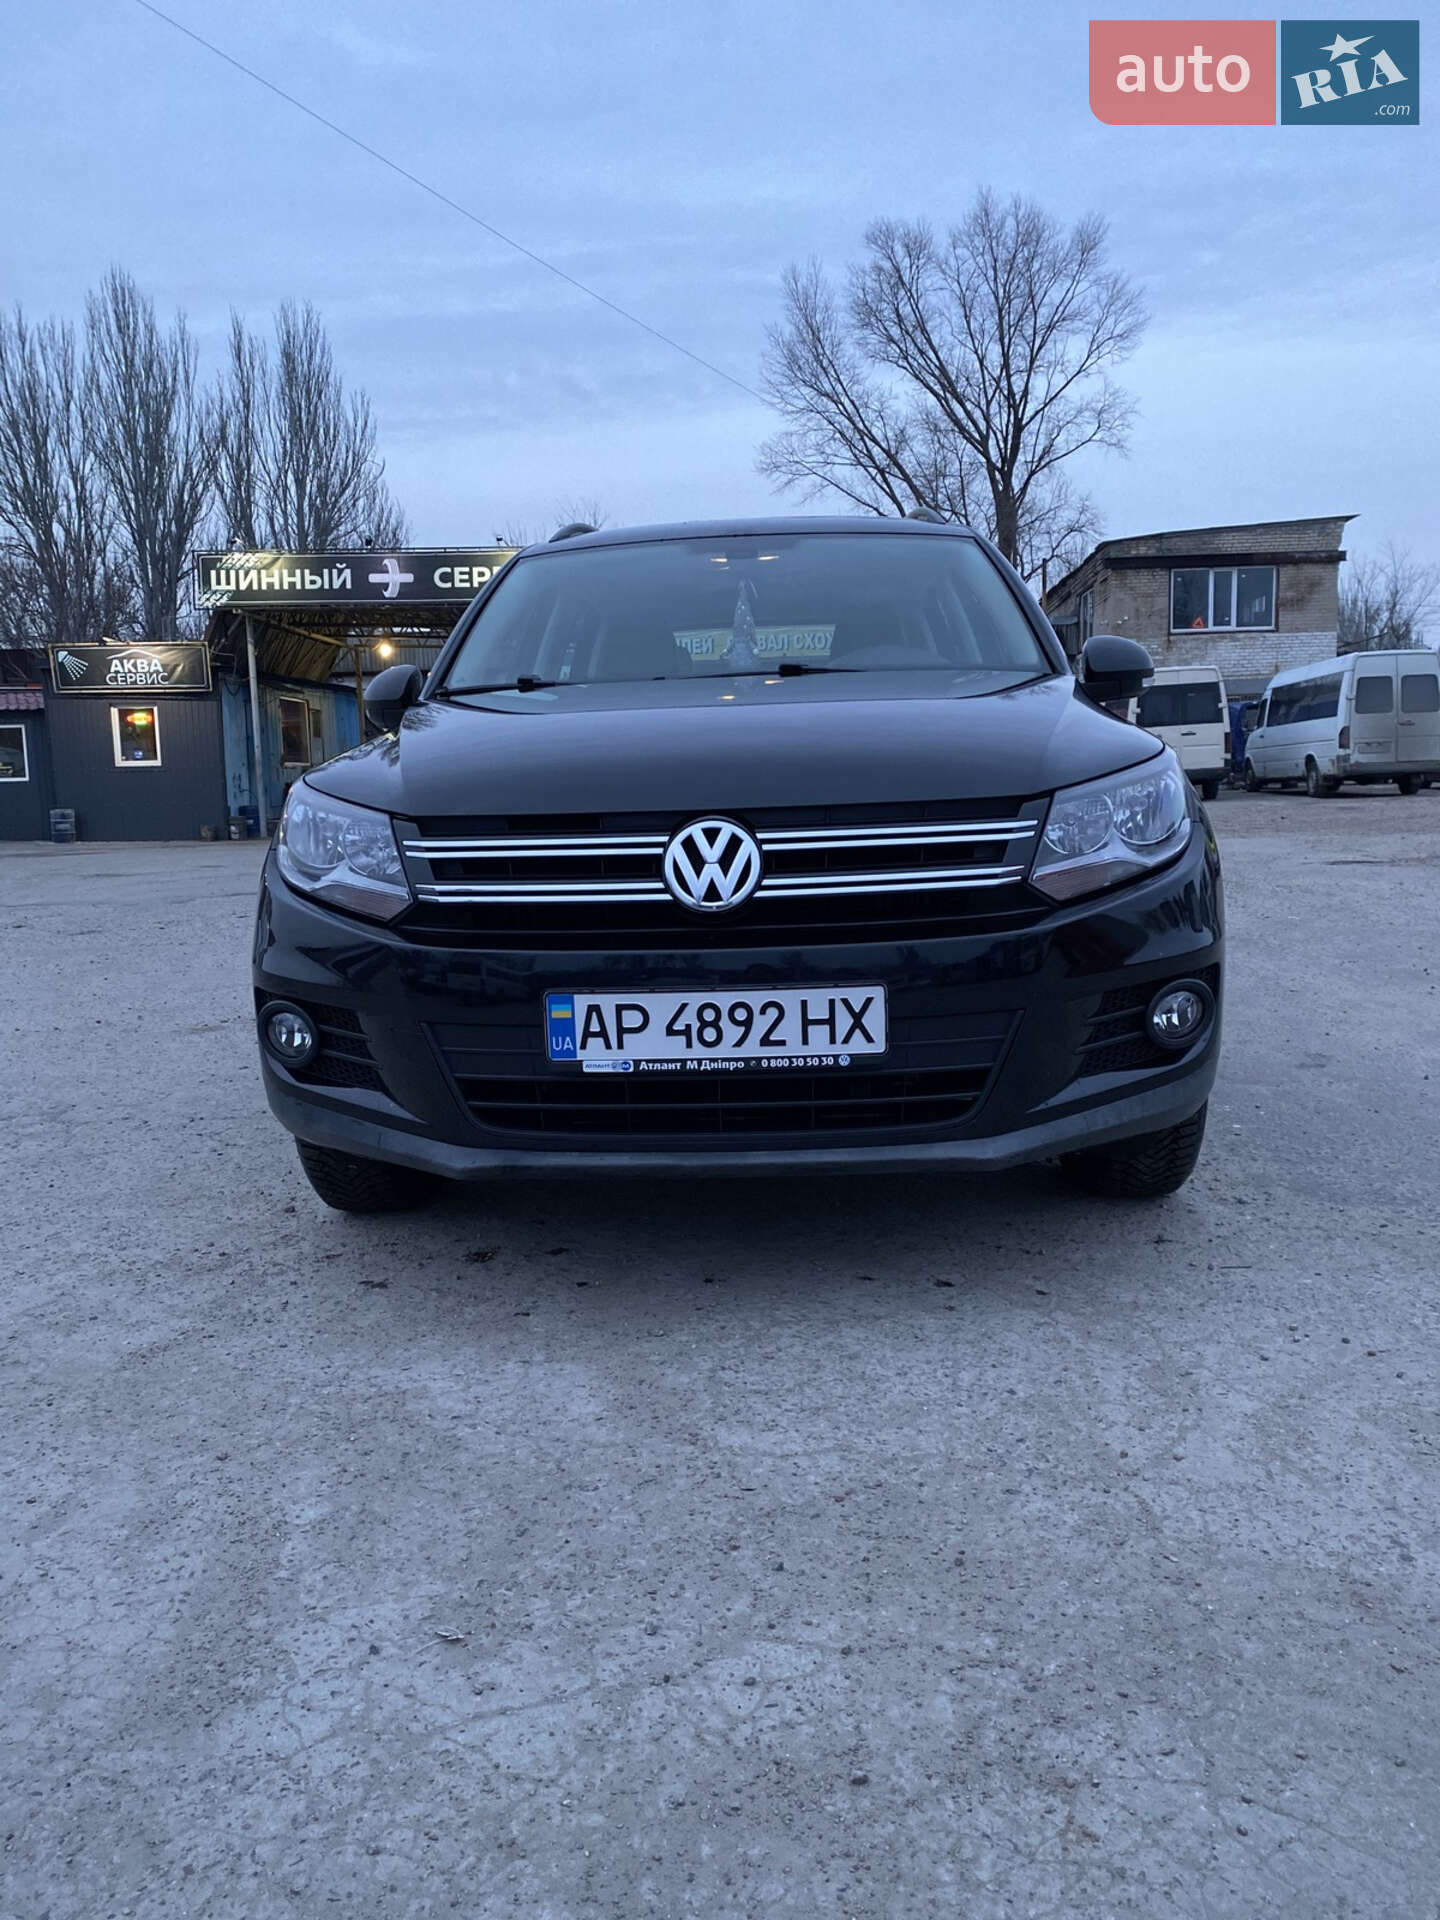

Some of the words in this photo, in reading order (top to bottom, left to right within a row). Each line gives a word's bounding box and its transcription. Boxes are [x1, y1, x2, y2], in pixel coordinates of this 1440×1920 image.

[210, 563, 352, 591] ШИННЫЙ
[109, 658, 163, 673] АКВА
[105, 672, 169, 685] СЕРВИС
[579, 1003, 650, 1050] AP
[665, 1000, 787, 1049] 4892
[800, 996, 876, 1046] HX
[552, 1036, 574, 1051] UA
[639, 1061, 682, 1071] Атлант
[686, 1060, 698, 1070] М
[700, 1060, 745, 1071] Дніпро
[761, 1058, 768, 1068] 0
[770, 1058, 790, 1068] 800
[791, 1058, 805, 1067] 30
[806, 1057, 820, 1067] 50
[821, 1056, 834, 1066] 30
